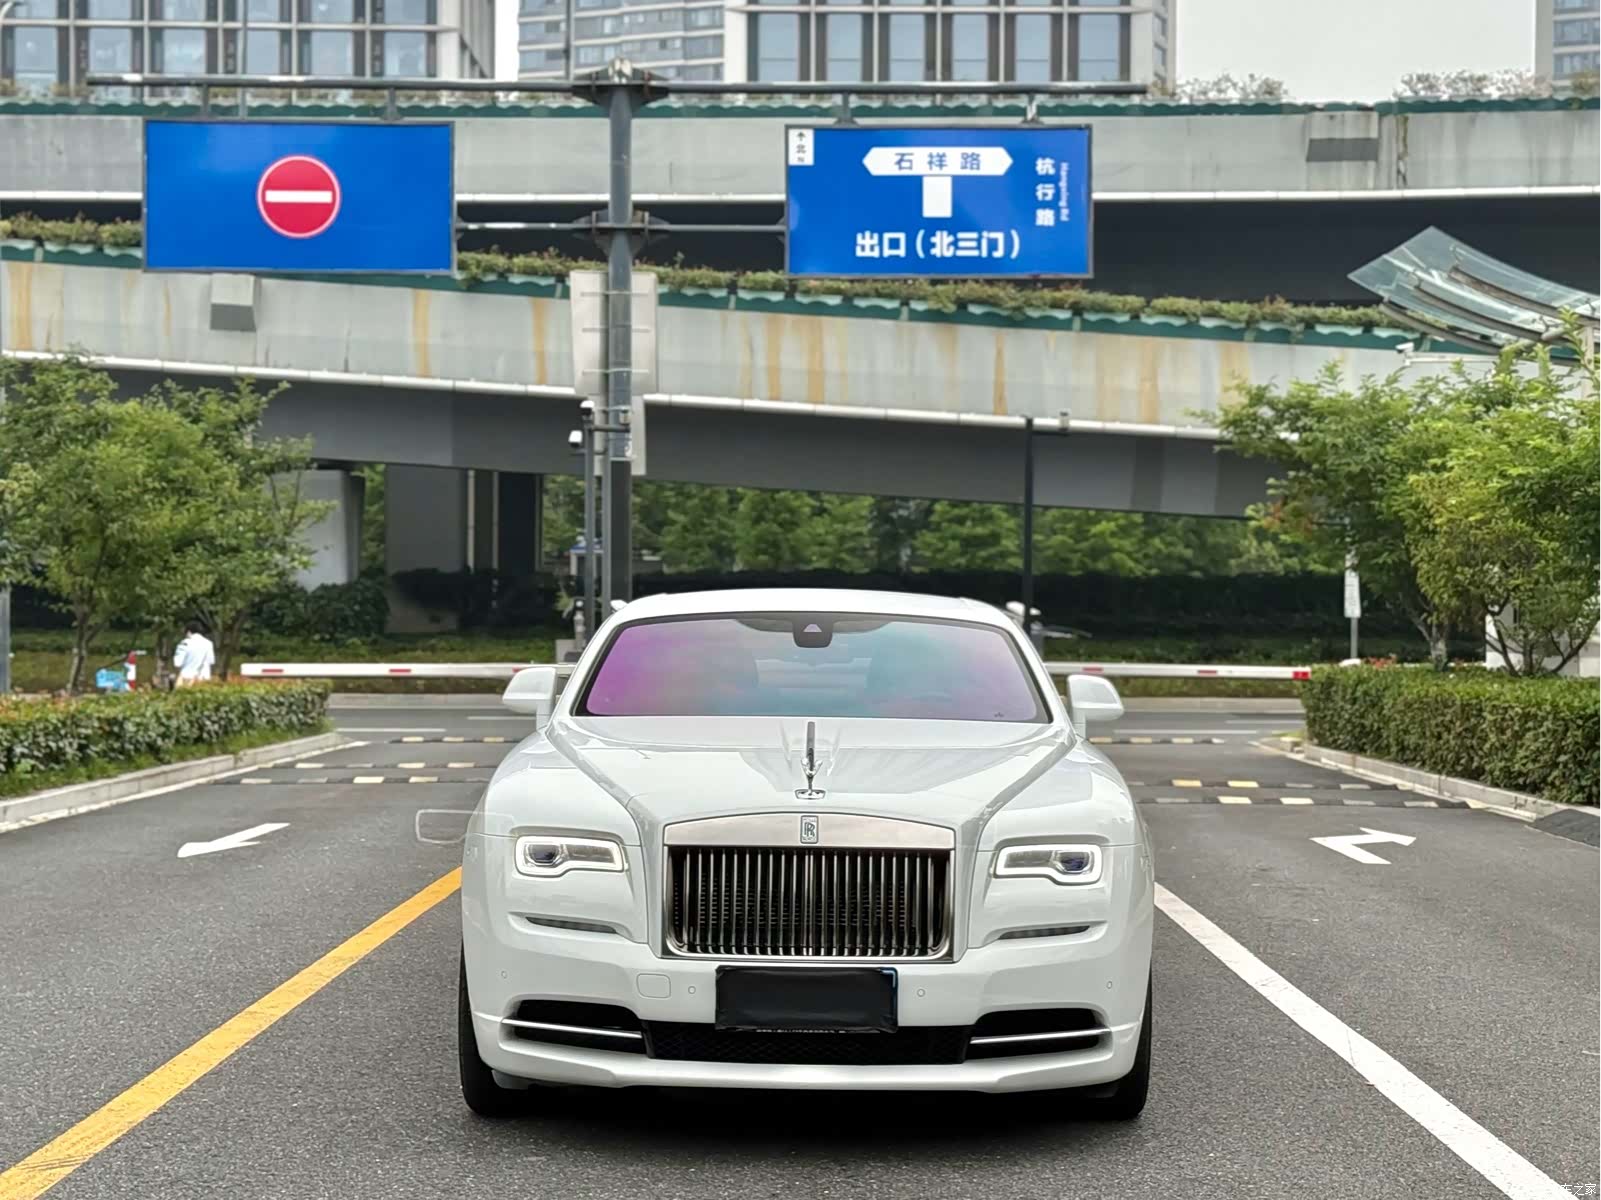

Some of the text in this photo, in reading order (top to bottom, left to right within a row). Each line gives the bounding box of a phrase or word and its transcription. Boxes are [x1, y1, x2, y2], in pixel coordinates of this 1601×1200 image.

[796, 144, 807, 154] 北
[894, 152, 982, 171] 石祥路
[1035, 157, 1056, 227] 杭行路
